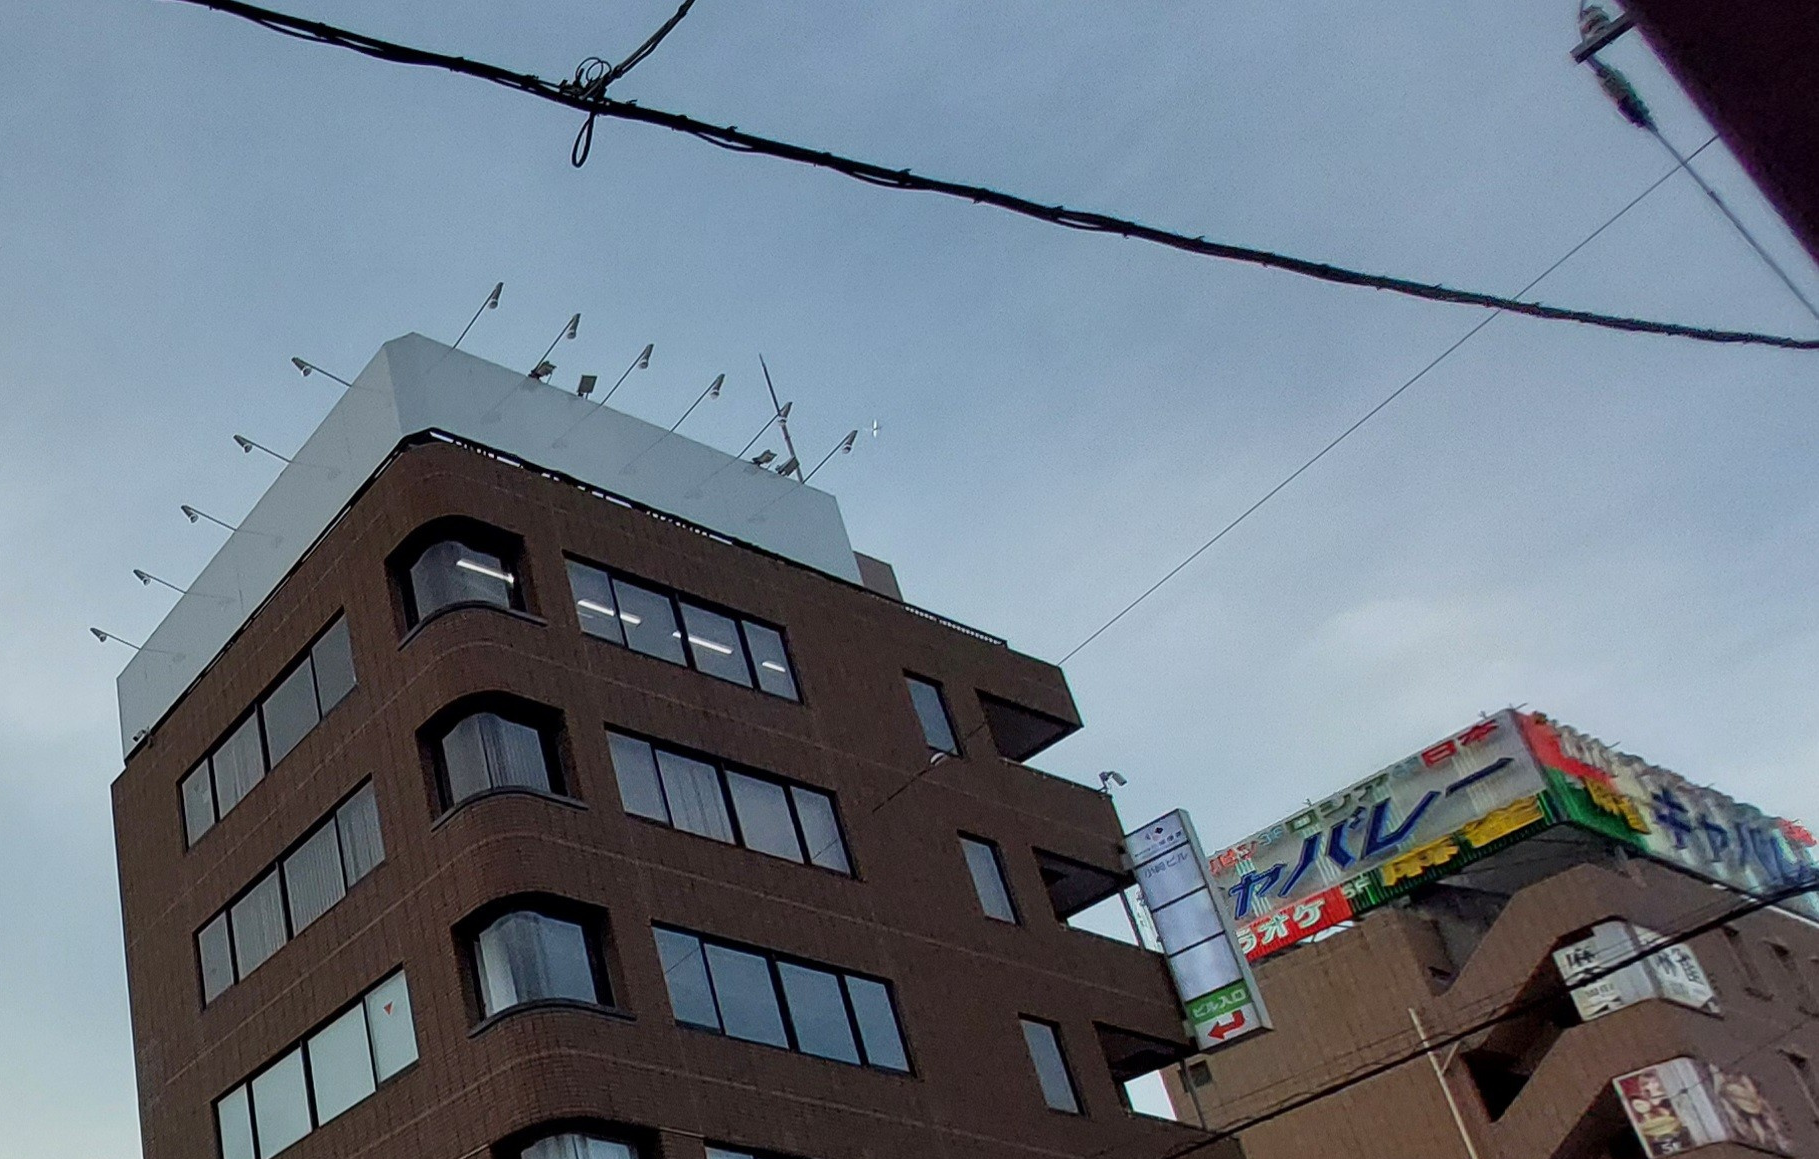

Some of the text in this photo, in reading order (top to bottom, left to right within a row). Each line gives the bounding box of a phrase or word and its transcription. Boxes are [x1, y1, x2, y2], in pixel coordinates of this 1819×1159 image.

[1422, 719, 1499, 768] 日本
[1217, 757, 1515, 920] ャバレー
